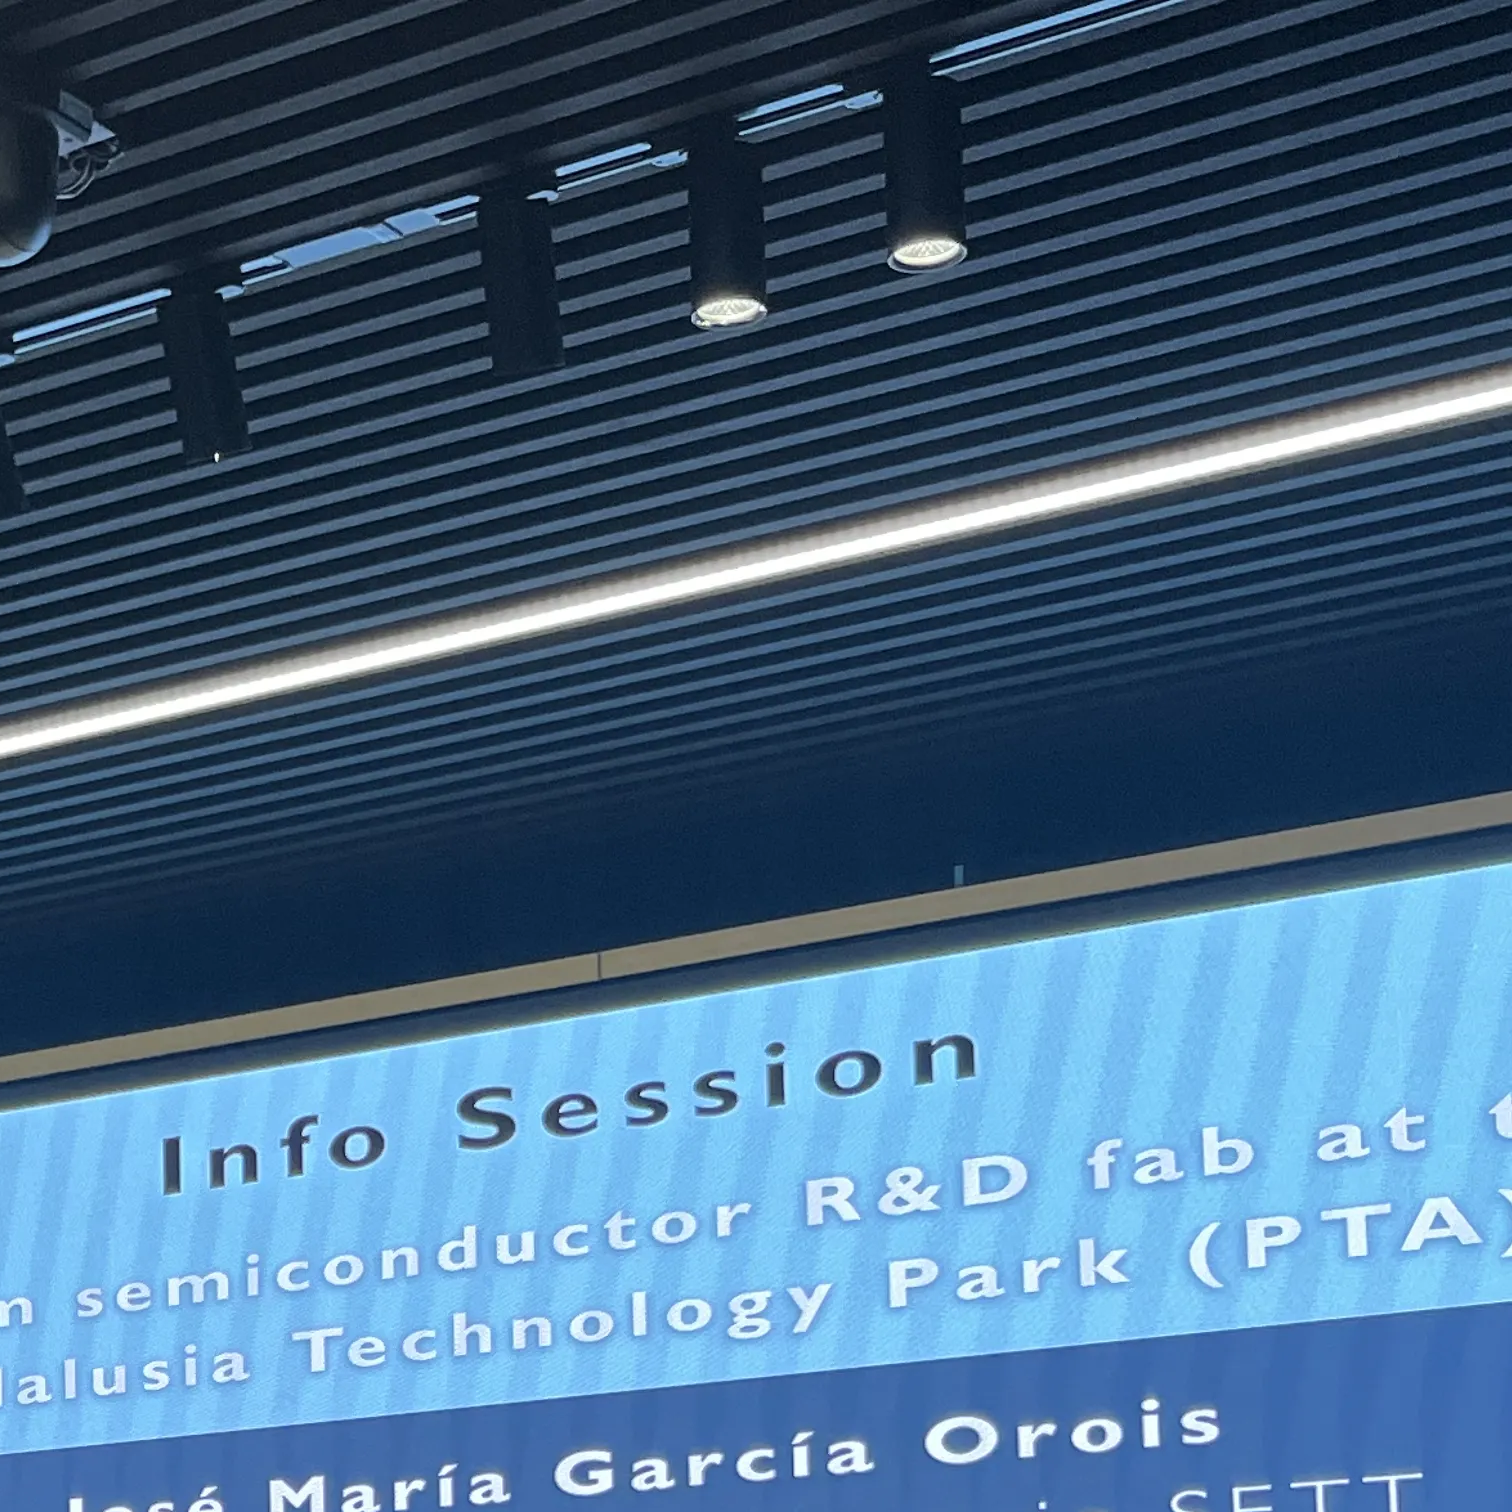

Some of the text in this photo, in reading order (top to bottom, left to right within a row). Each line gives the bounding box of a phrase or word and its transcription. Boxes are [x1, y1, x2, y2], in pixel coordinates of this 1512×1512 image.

[163, 1033, 977, 1195] Info Session
[77, 1202, 752, 1318] semiconductor
[805, 1154, 1029, 1226] R&D
[1087, 1125, 1255, 1190] fab
[1316, 1105, 1427, 1162] at
[291, 1281, 833, 1373] Technology
[888, 1238, 1130, 1309] Park
[554, 1430, 875, 1497] García
[923, 1396, 1222, 1465] Orois
